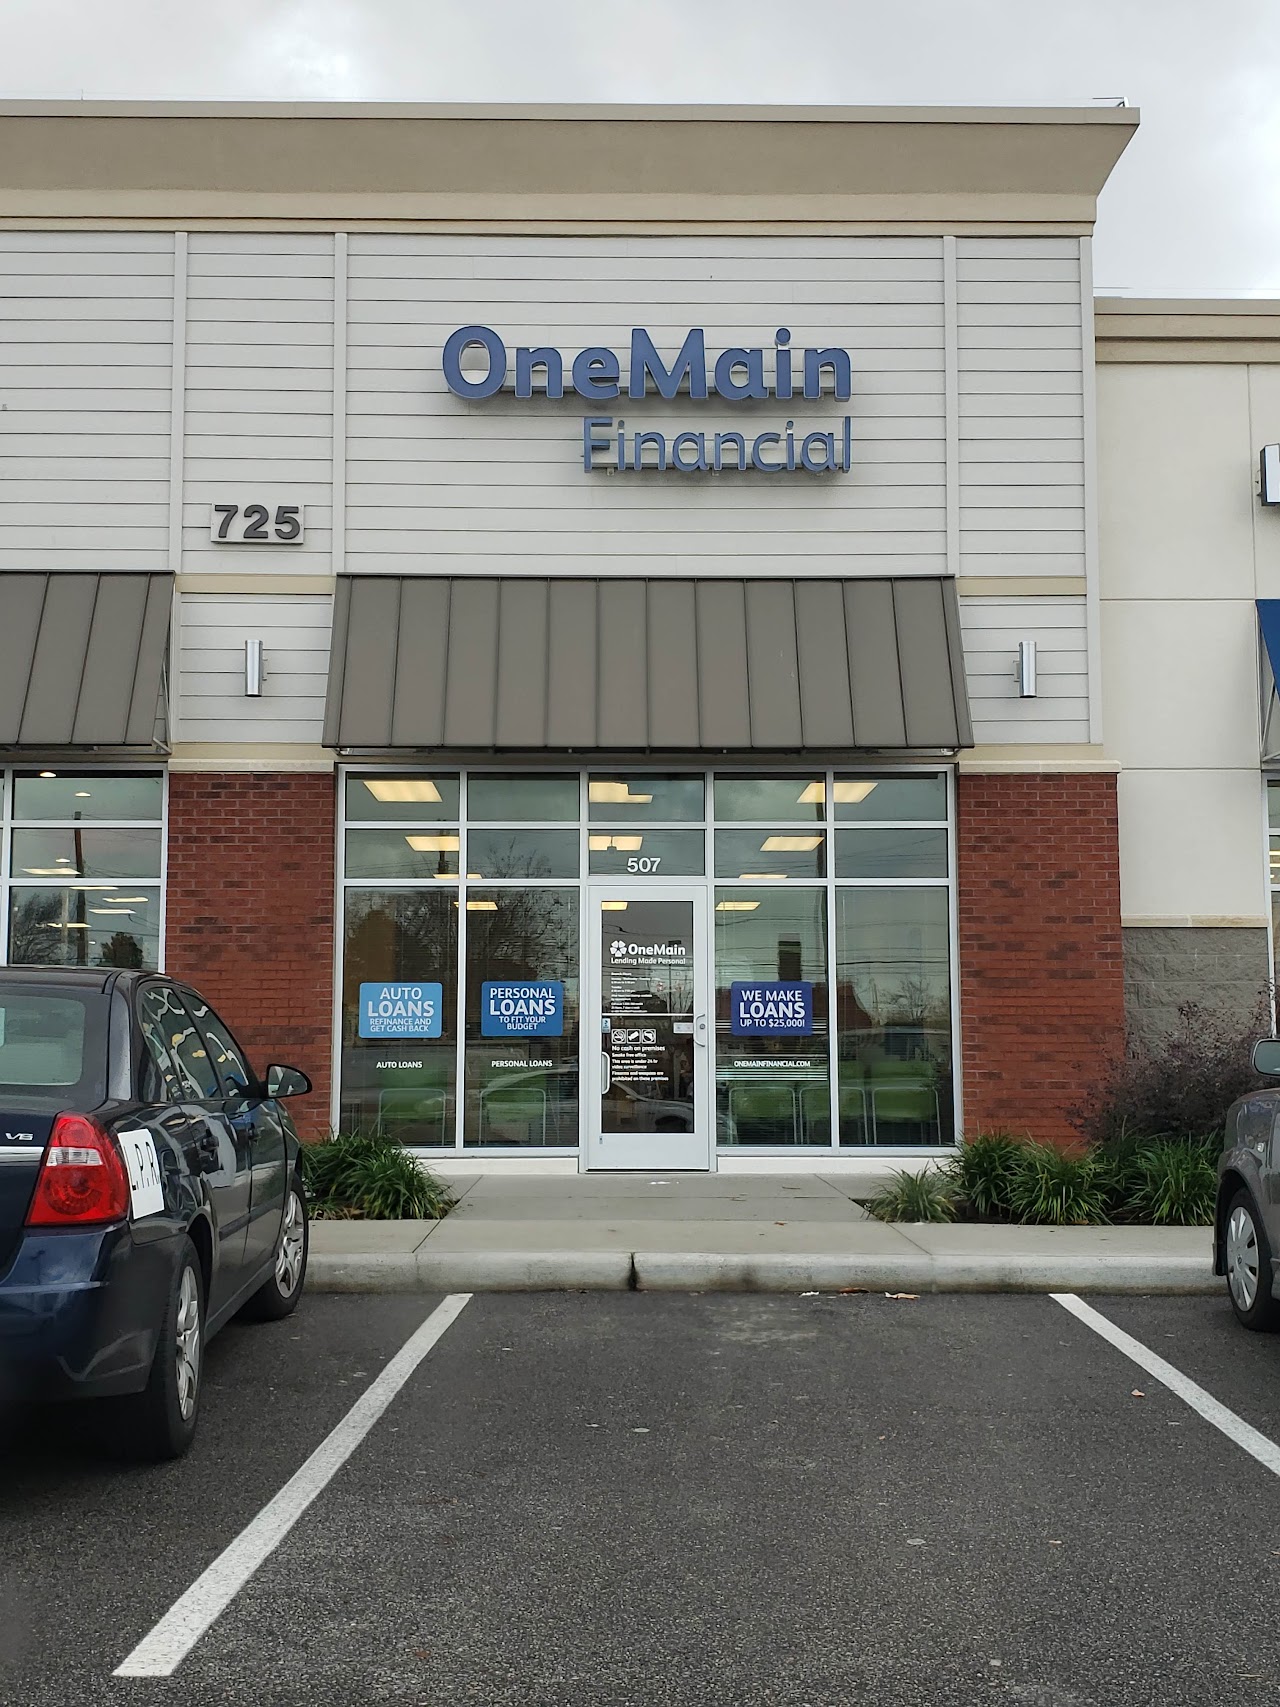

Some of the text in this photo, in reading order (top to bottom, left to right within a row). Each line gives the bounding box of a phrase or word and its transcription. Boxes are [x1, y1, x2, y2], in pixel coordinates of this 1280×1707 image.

[442, 325, 851, 401] OneMain
[583, 416, 851, 473] Financial
[215, 504, 300, 540] 725
[626, 857, 661, 873] 507
[628, 943, 686, 956] OneMain
[610, 957, 637, 965] Lending
[638, 957, 657, 965] Made
[380, 987, 422, 1000] AUTO
[490, 987, 555, 999] PERSONAL
[741, 990, 802, 1001] WE MAKE
[368, 1000, 434, 1017] LOANS
[490, 999, 556, 1016] LOANS
[740, 1002, 805, 1018] LOANS
[740, 1019, 805, 1028] UP TO $25,000!
[376, 1061, 423, 1069] AUTO LOANS
[5, 1132, 34, 1141] V6
